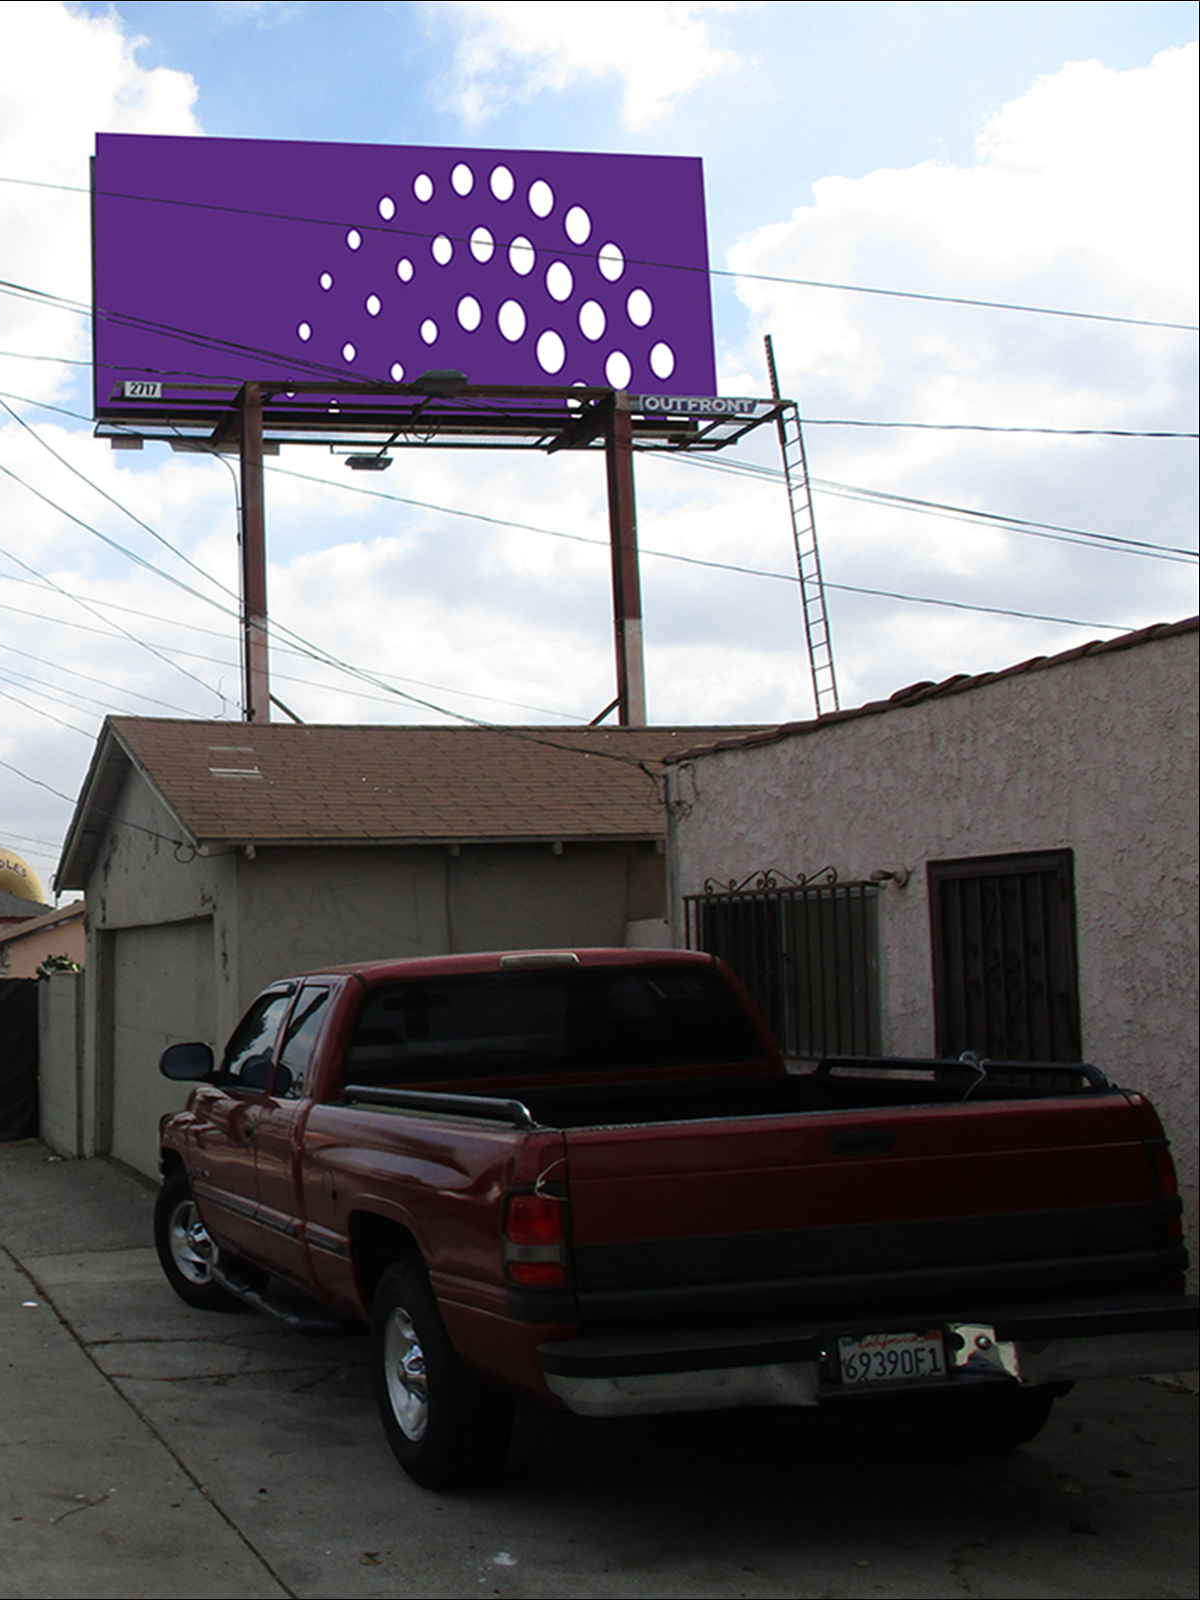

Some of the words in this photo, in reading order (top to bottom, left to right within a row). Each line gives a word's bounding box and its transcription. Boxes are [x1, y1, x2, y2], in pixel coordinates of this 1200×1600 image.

[130, 381, 158, 396] 2717
[645, 396, 752, 412] OUTFRONT
[845, 1346, 942, 1379] 69390F1
